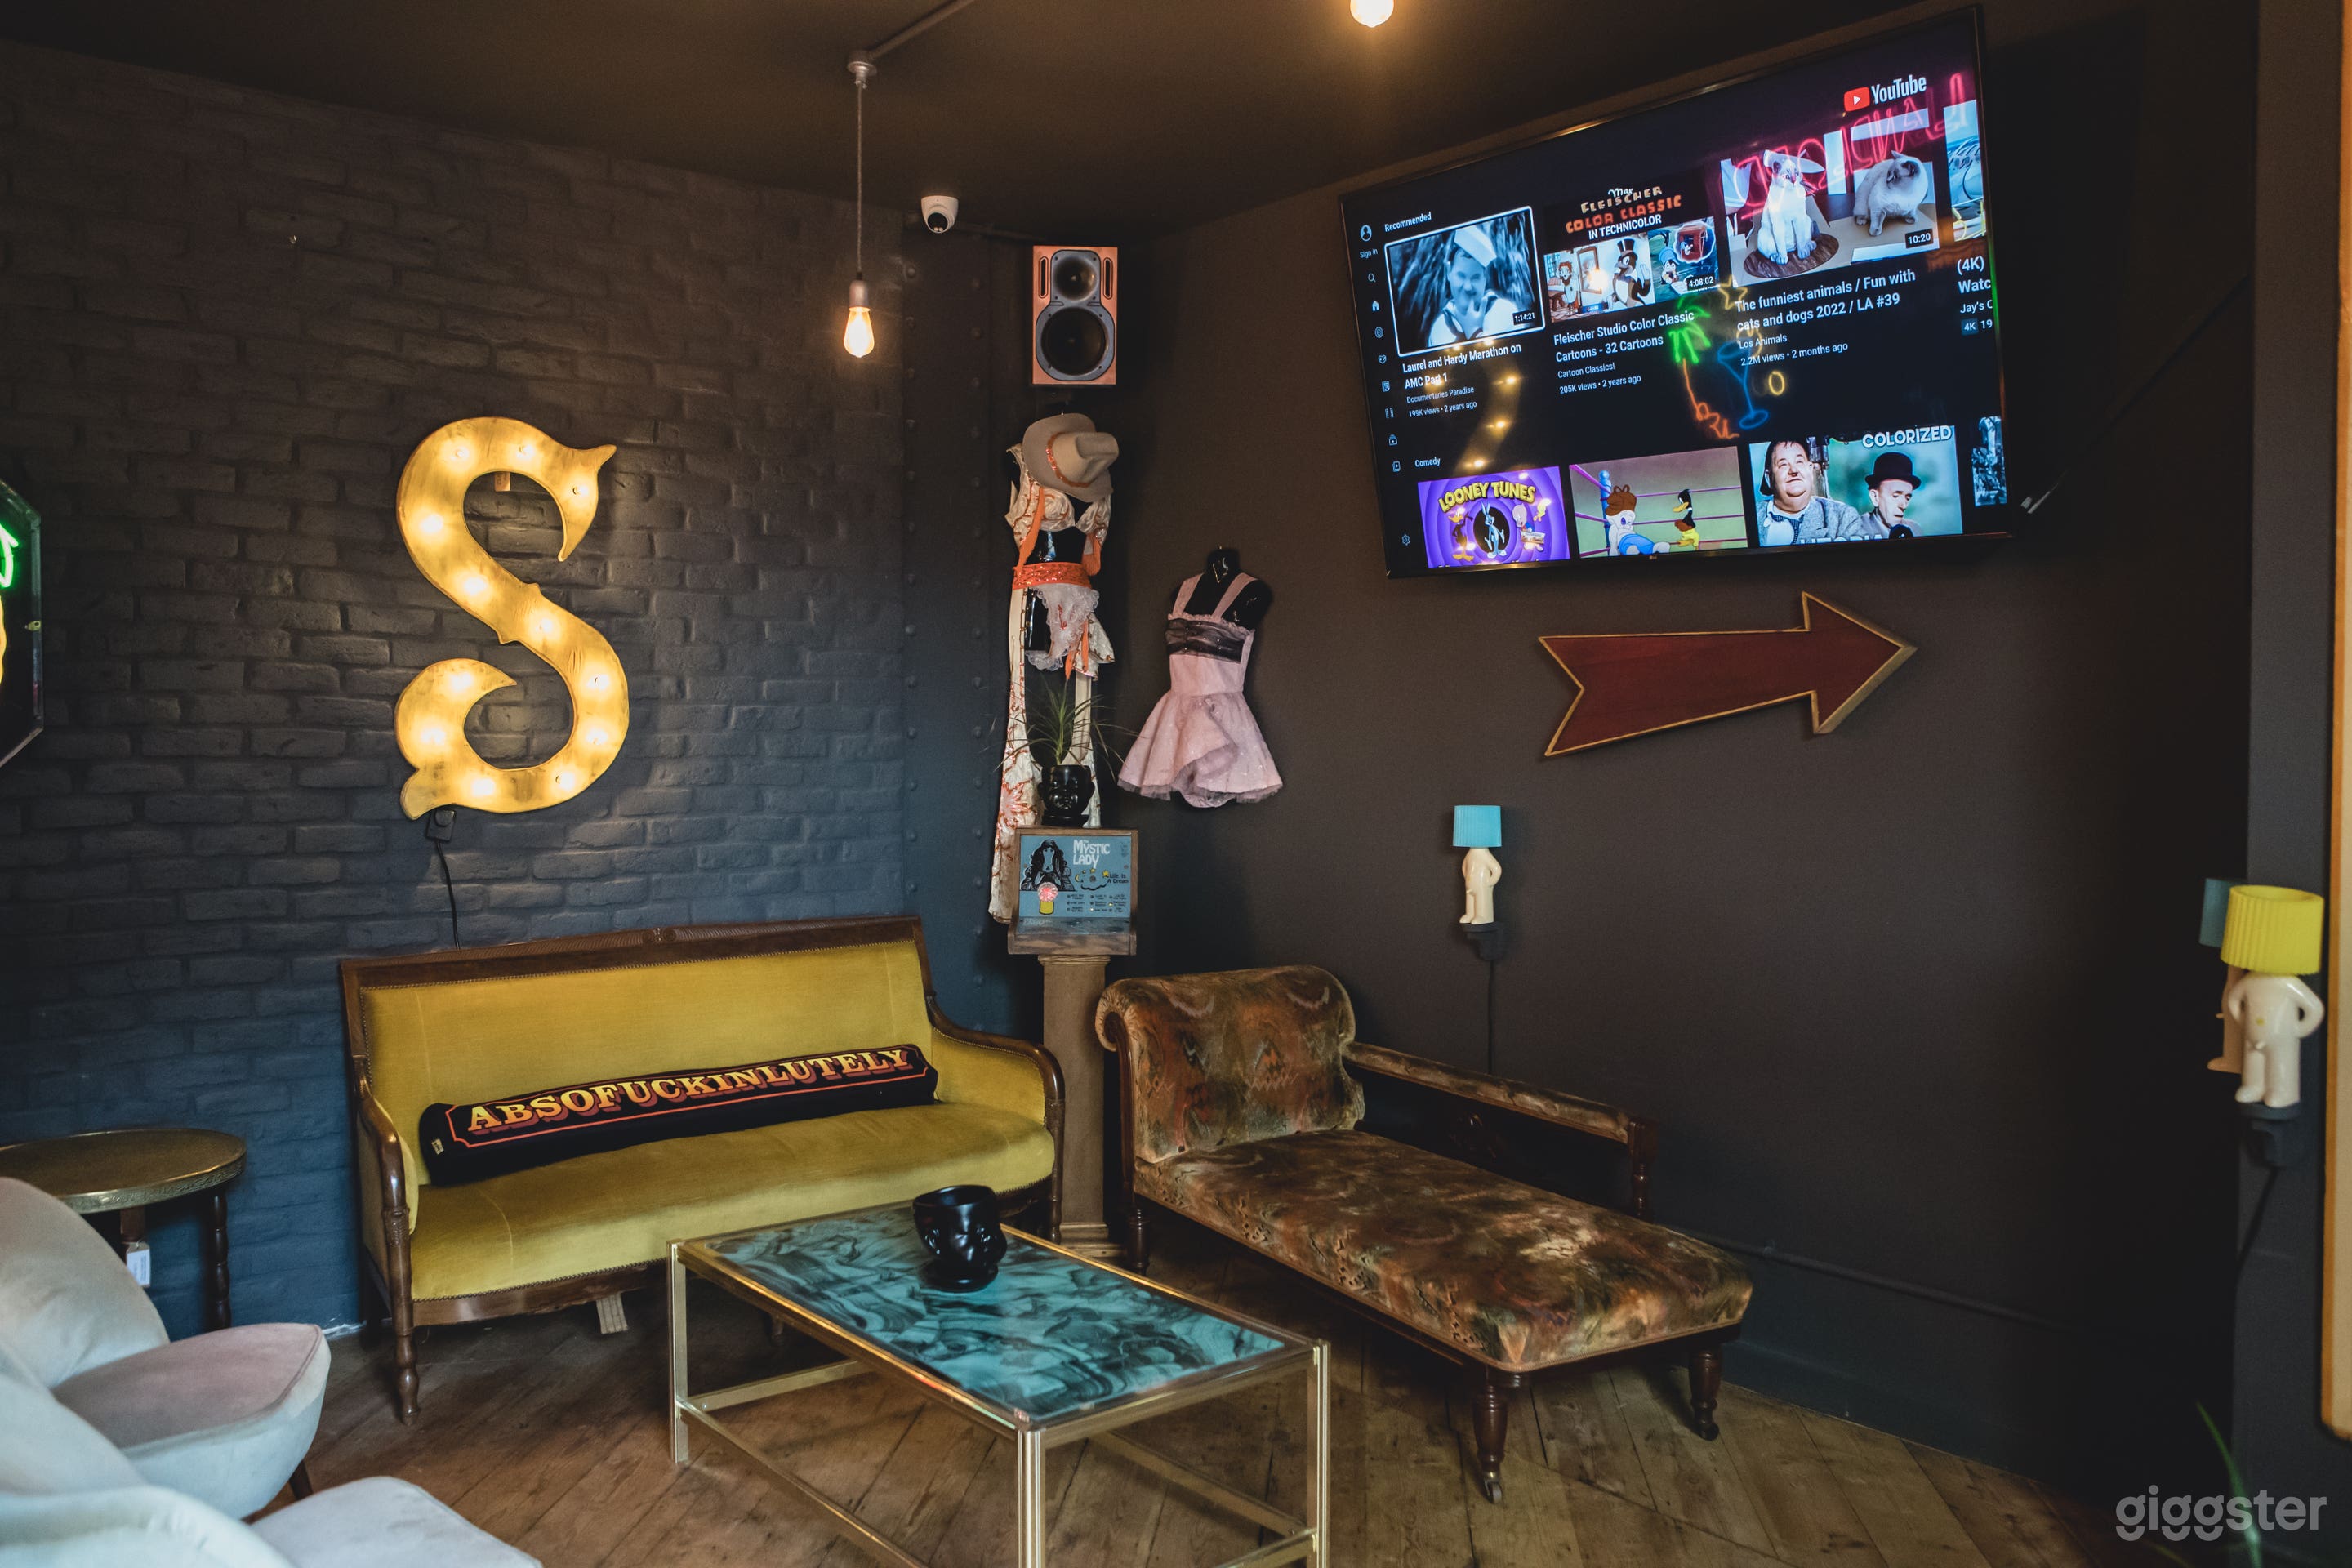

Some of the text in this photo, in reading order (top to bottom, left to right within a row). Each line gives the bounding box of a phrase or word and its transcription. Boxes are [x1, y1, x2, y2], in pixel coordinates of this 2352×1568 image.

[1871, 74, 1927, 105] YouTube
[1580, 186, 1663, 214] FLEISCHER
[1608, 188, 1633, 198] Max
[1384, 212, 1432, 232] Recommended
[1566, 194, 1682, 234] COLOR CLASSIC
[1588, 214, 1662, 240] IN TECHNICOLOR
[1908, 233, 1931, 245] 10:20
[1359, 249, 1371, 259] Sign
[1957, 255, 1984, 275] (4K)
[1689, 276, 1714, 287] 4:08:02
[1735, 298, 1756, 314] The
[1758, 292, 1804, 310] funniest
[1807, 282, 1852, 301] animals
[1864, 275, 1887, 290] Fun
[1890, 269, 1916, 284] with
[1515, 312, 1535, 323] 1:14:21
[1737, 318, 1760, 332] cats
[1762, 313, 1783, 327] and
[1786, 308, 1813, 325] dogs
[1816, 302, 1846, 318] 2022
[1857, 296, 1873, 311] LA
[1876, 292, 1900, 308] #39
[1960, 301, 1984, 314] Jay's
[1553, 310, 1695, 346] Fleischer Studio Color Classic
[1964, 322, 1976, 331] 4K
[1556, 346, 1597, 363] Cartoons
[1605, 342, 1618, 354] 32
[1619, 336, 1664, 351] Cartoons
[1739, 333, 1788, 350] Los Animals
[1402, 344, 1522, 373] Laurel and Hardy Marathon on
[1740, 341, 1848, 367] 2.2M views 2 months ago
[1405, 377, 1423, 390] AMC
[1442, 372, 1448, 382] 1
[1557, 367, 1584, 379] Cartoon
[1449, 385, 1474, 397] Paradise
[1559, 374, 1642, 394] 205K views 2 years ago
[1423, 406, 1440, 416] views
[1444, 404, 1449, 412] 2
[1449, 403, 1465, 413] years
[1466, 401, 1477, 410] ago
[1862, 425, 1953, 448] COLORIZED
[1414, 457, 1441, 468] Comedy
[1438, 480, 1535, 513] LOONEY TUNES
[1073, 839, 1111, 855] MYSTIC
[1073, 855, 1099, 869] LADY
[466, 1049, 910, 1134] ABSOFUCKINLUTELY
